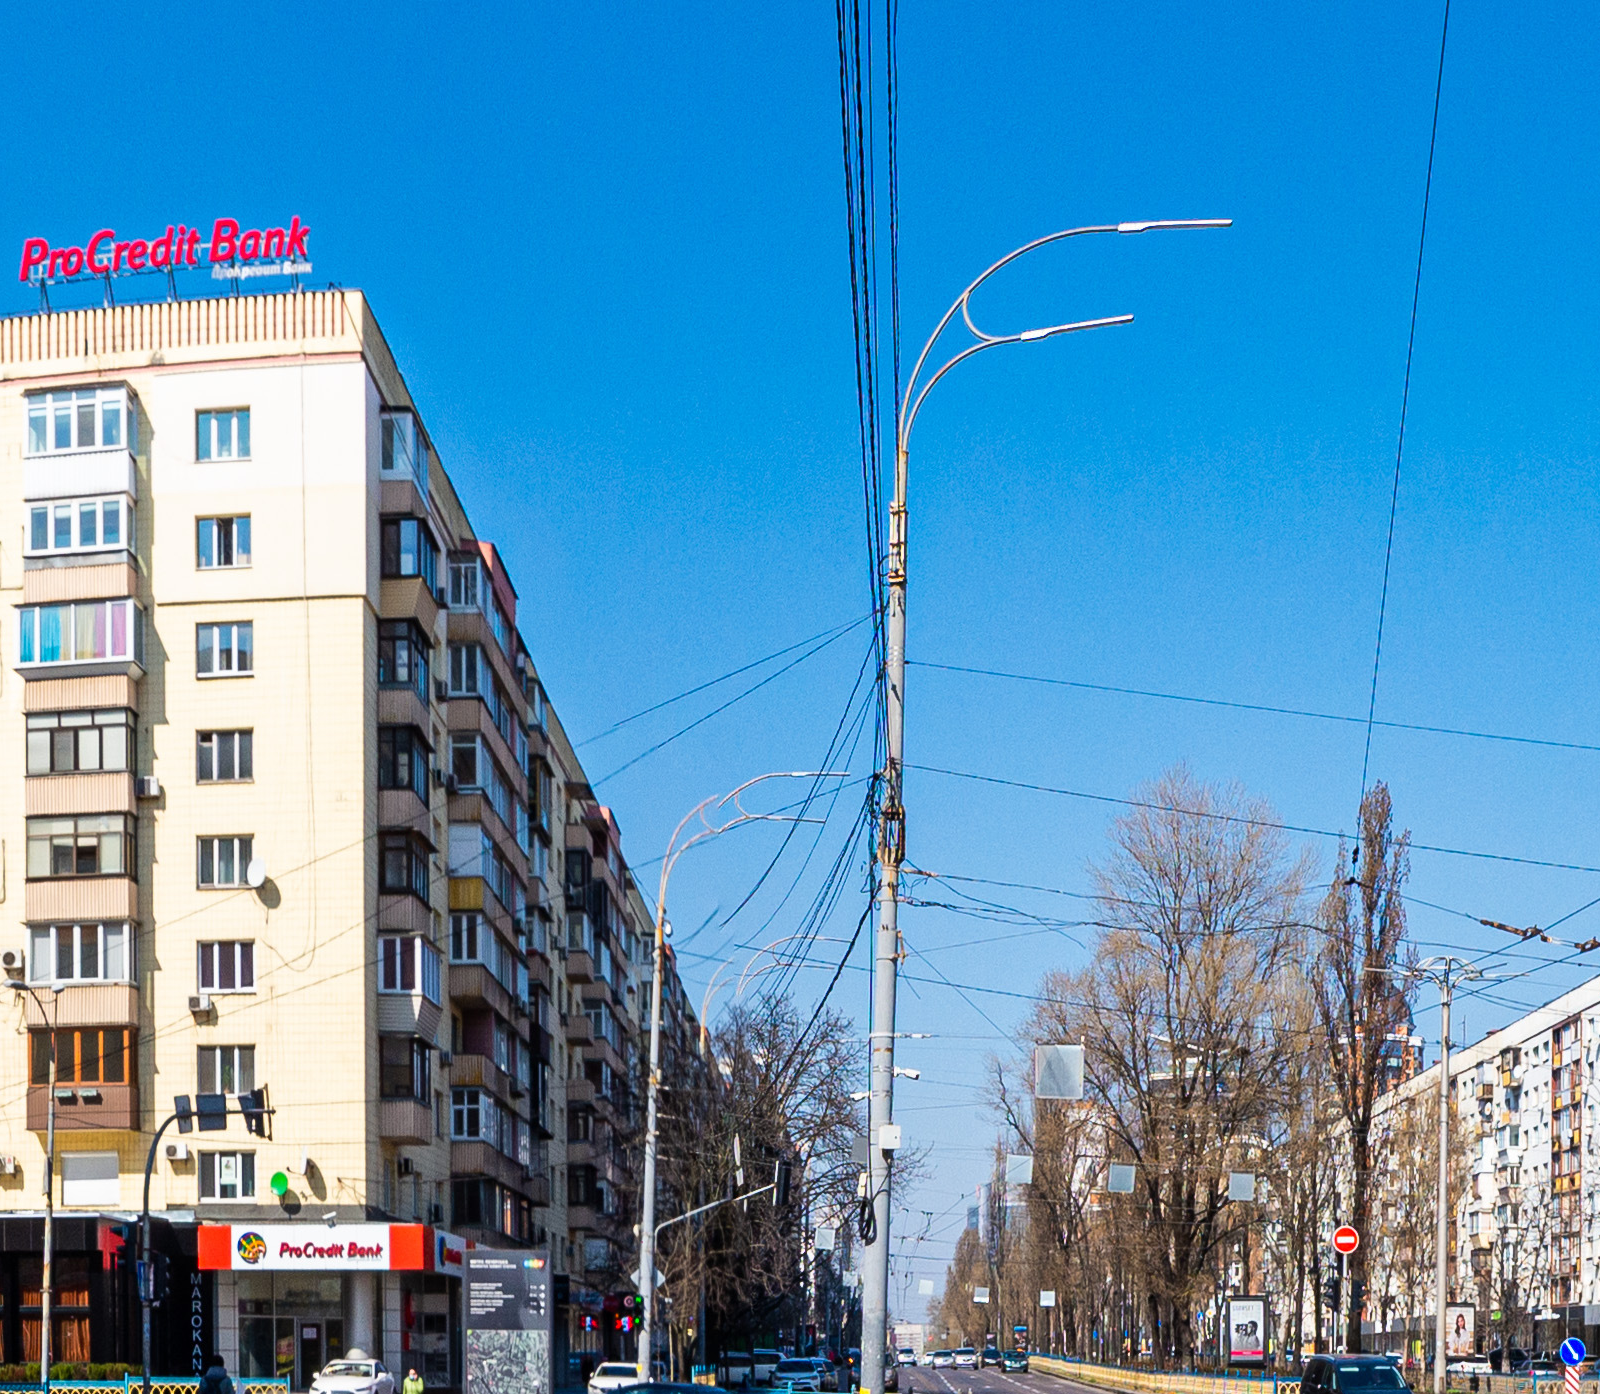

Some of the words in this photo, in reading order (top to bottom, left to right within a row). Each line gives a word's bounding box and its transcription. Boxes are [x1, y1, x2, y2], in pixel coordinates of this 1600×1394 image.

[19, 224, 201, 282] ProCredit
[208, 214, 311, 262] Bank
[279, 1242, 344, 1259] ProCredit
[347, 1241, 384, 1259] Bank
